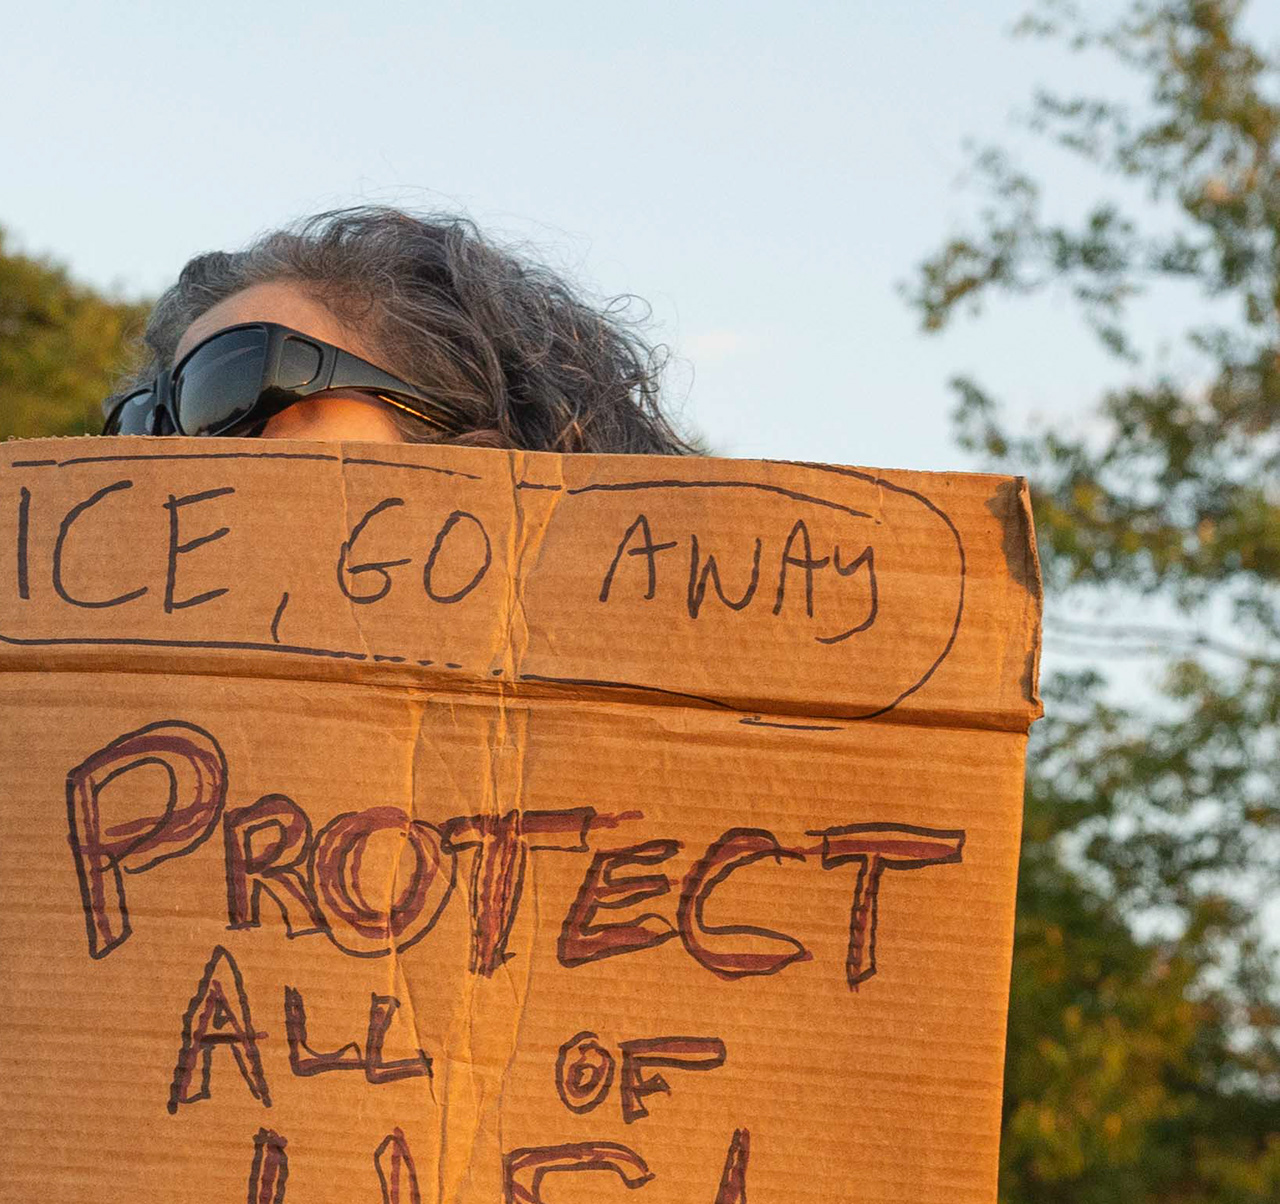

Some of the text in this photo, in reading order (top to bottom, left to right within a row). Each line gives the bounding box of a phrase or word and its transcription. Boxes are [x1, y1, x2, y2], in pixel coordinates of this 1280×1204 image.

[16, 481, 289, 644] ICE,
[336, 497, 493, 603] GO
[64, 719, 966, 992] PROTECT
[166, 945, 433, 1114] ALL
[554, 1030, 728, 1122] OF
